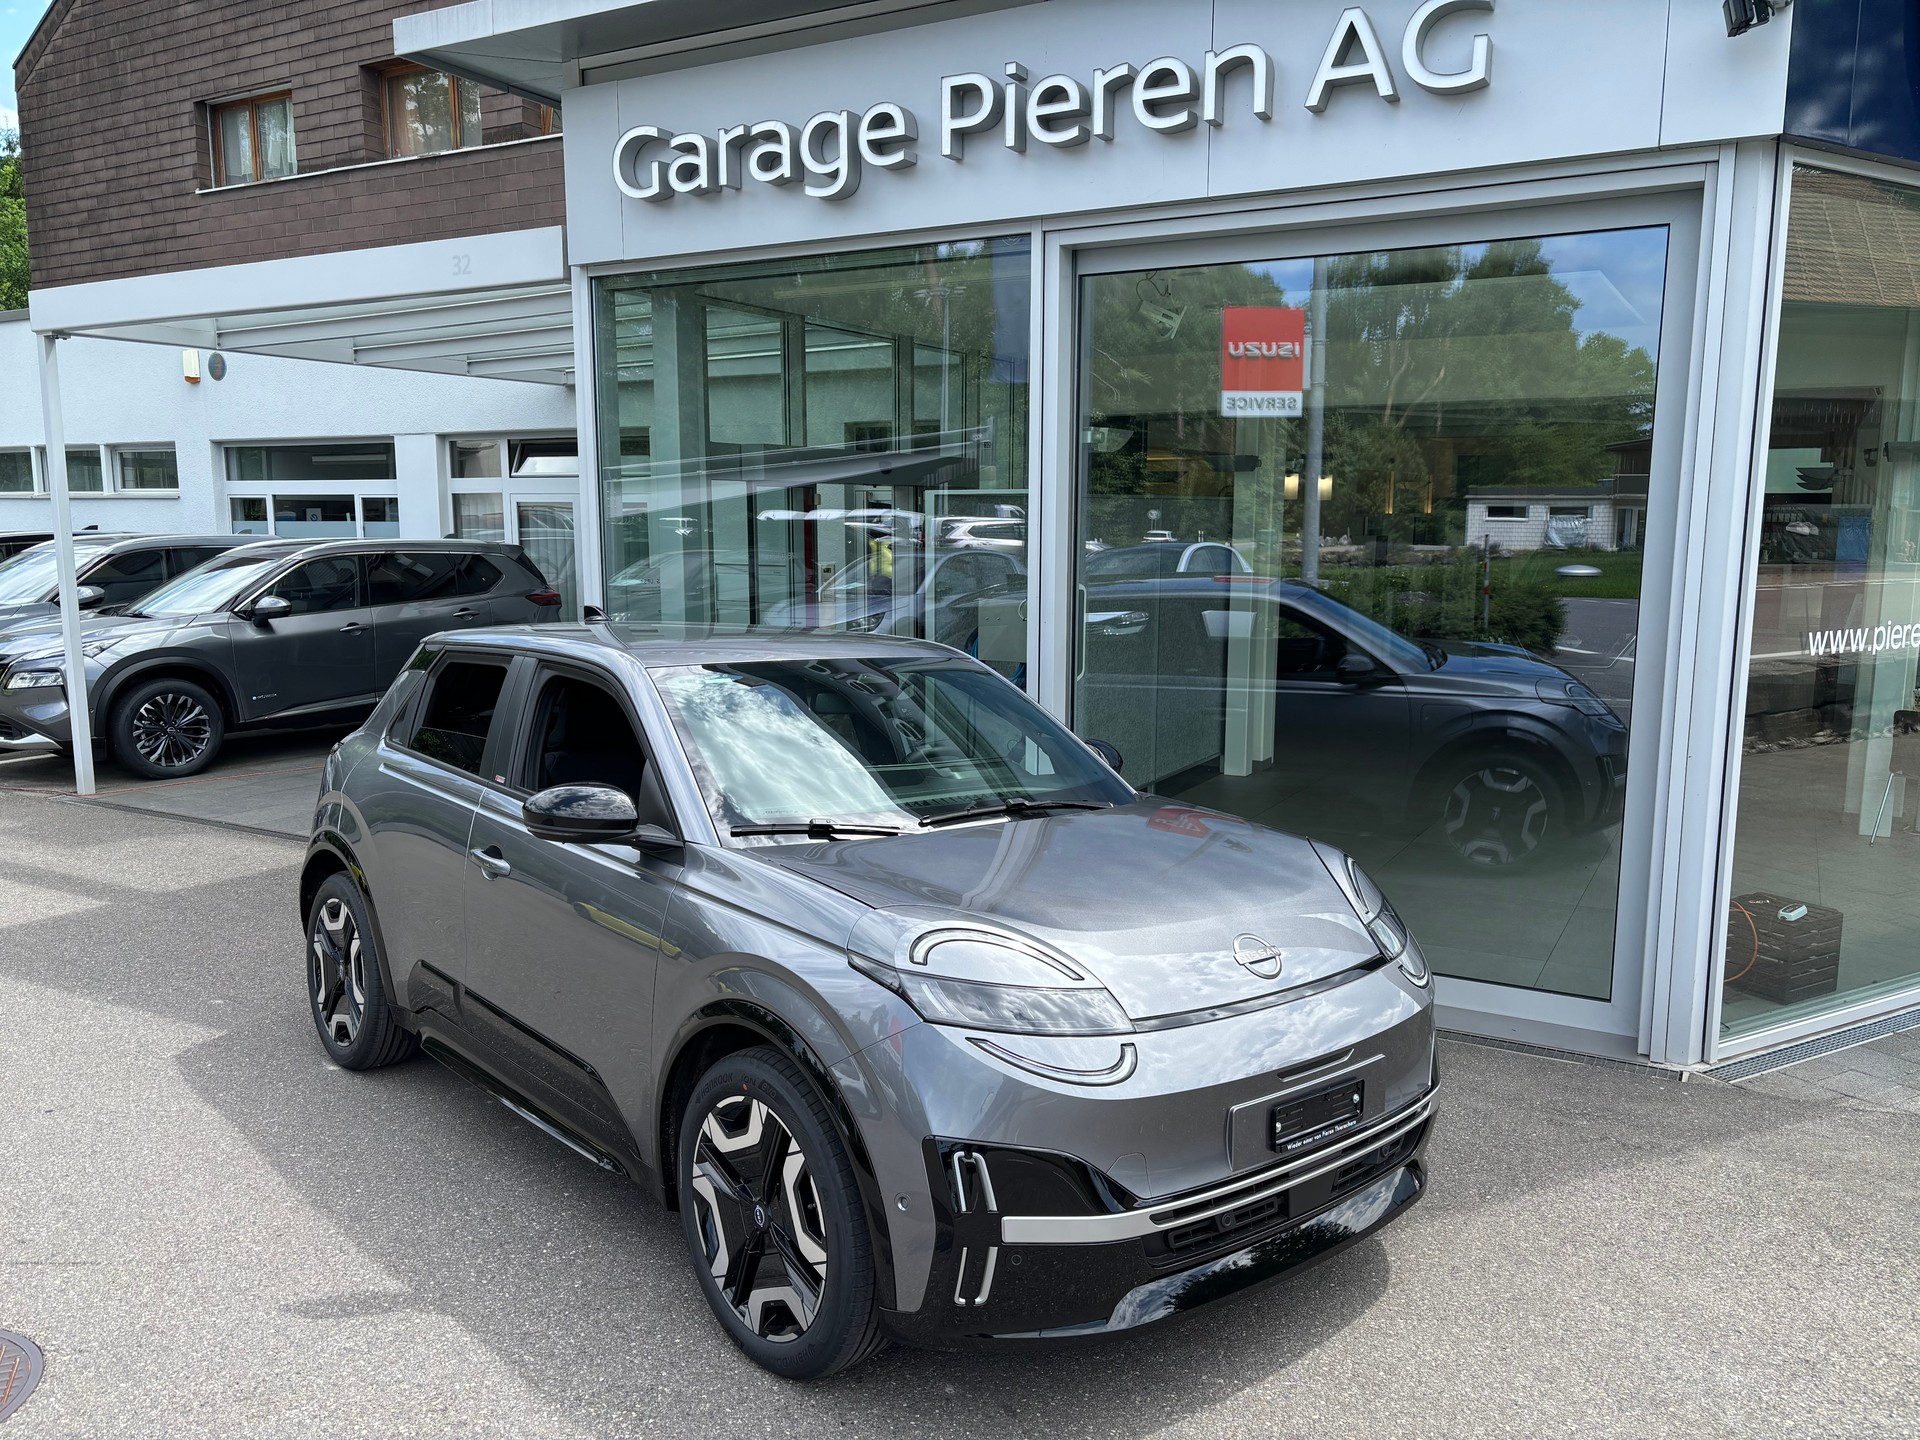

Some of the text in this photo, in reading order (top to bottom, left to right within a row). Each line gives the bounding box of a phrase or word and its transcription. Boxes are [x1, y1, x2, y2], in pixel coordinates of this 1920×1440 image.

[612, 0, 1495, 201] Garage Pieren AG
[452, 254, 473, 276] 32
[1239, 946, 1280, 961] NISSAN
